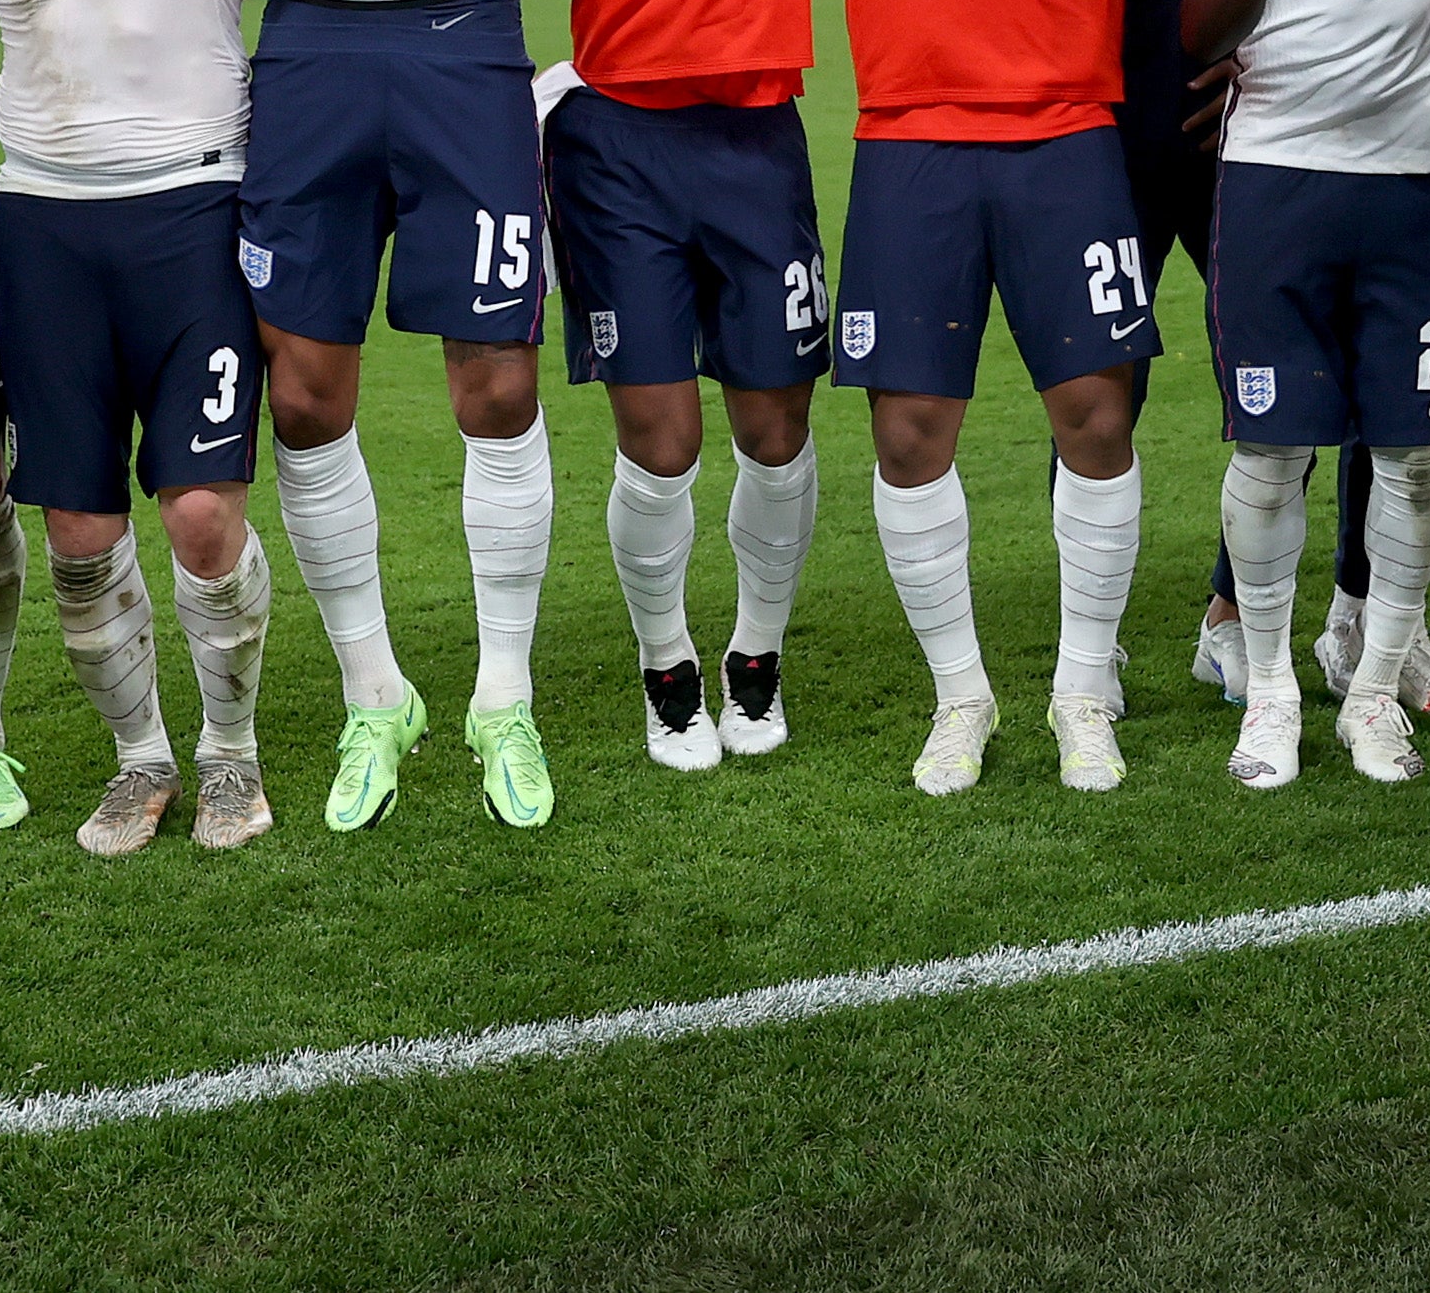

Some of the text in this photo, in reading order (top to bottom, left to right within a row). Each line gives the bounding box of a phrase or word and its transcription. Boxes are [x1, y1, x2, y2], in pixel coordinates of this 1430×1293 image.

[473, 208, 532, 290] 15
[1083, 236, 1148, 315] 24
[784, 253, 828, 332] 26
[202, 346, 239, 424] 3
